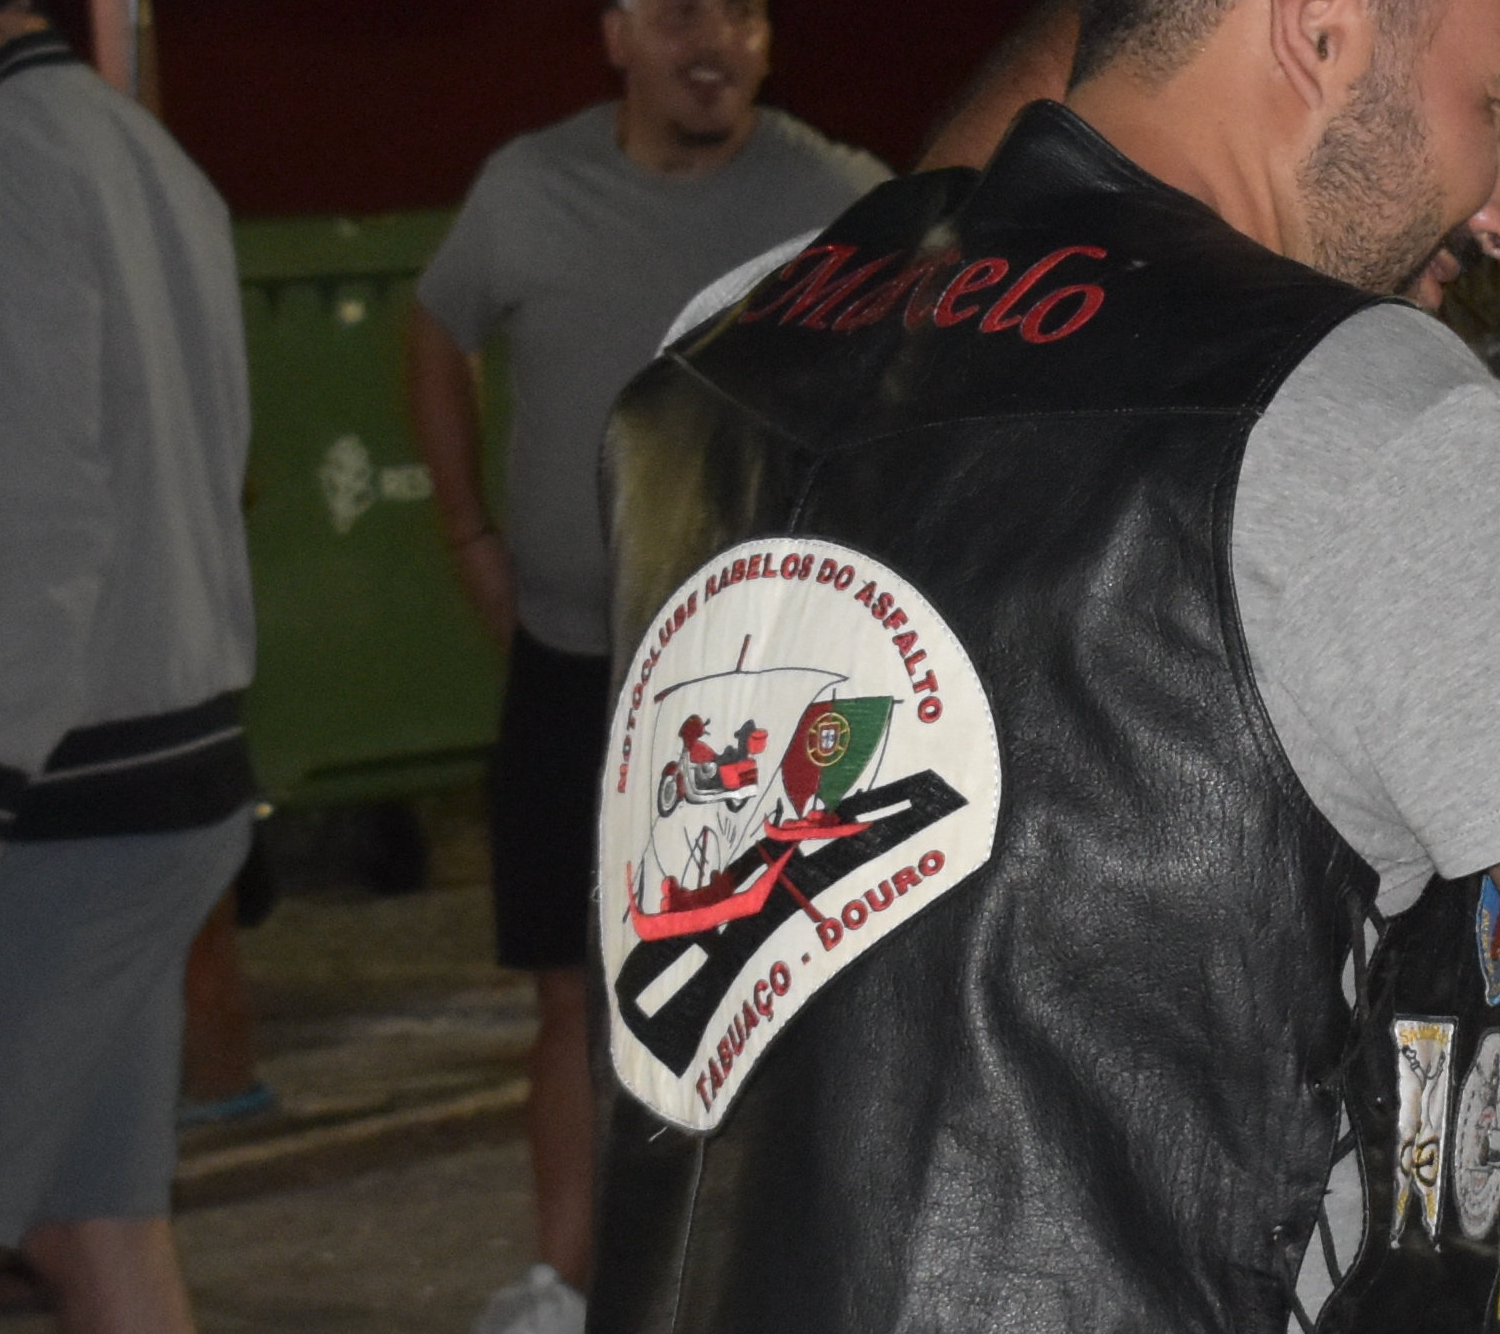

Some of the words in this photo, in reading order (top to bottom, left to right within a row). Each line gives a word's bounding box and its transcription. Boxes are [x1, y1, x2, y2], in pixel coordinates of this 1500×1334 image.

[705, 552, 815, 603] RABELOS
[816, 556, 856, 592] DO
[854, 580, 943, 724] ASFALTO
[694, 959, 792, 1114] TABUAÇO
[814, 849, 946, 952] DOURO
